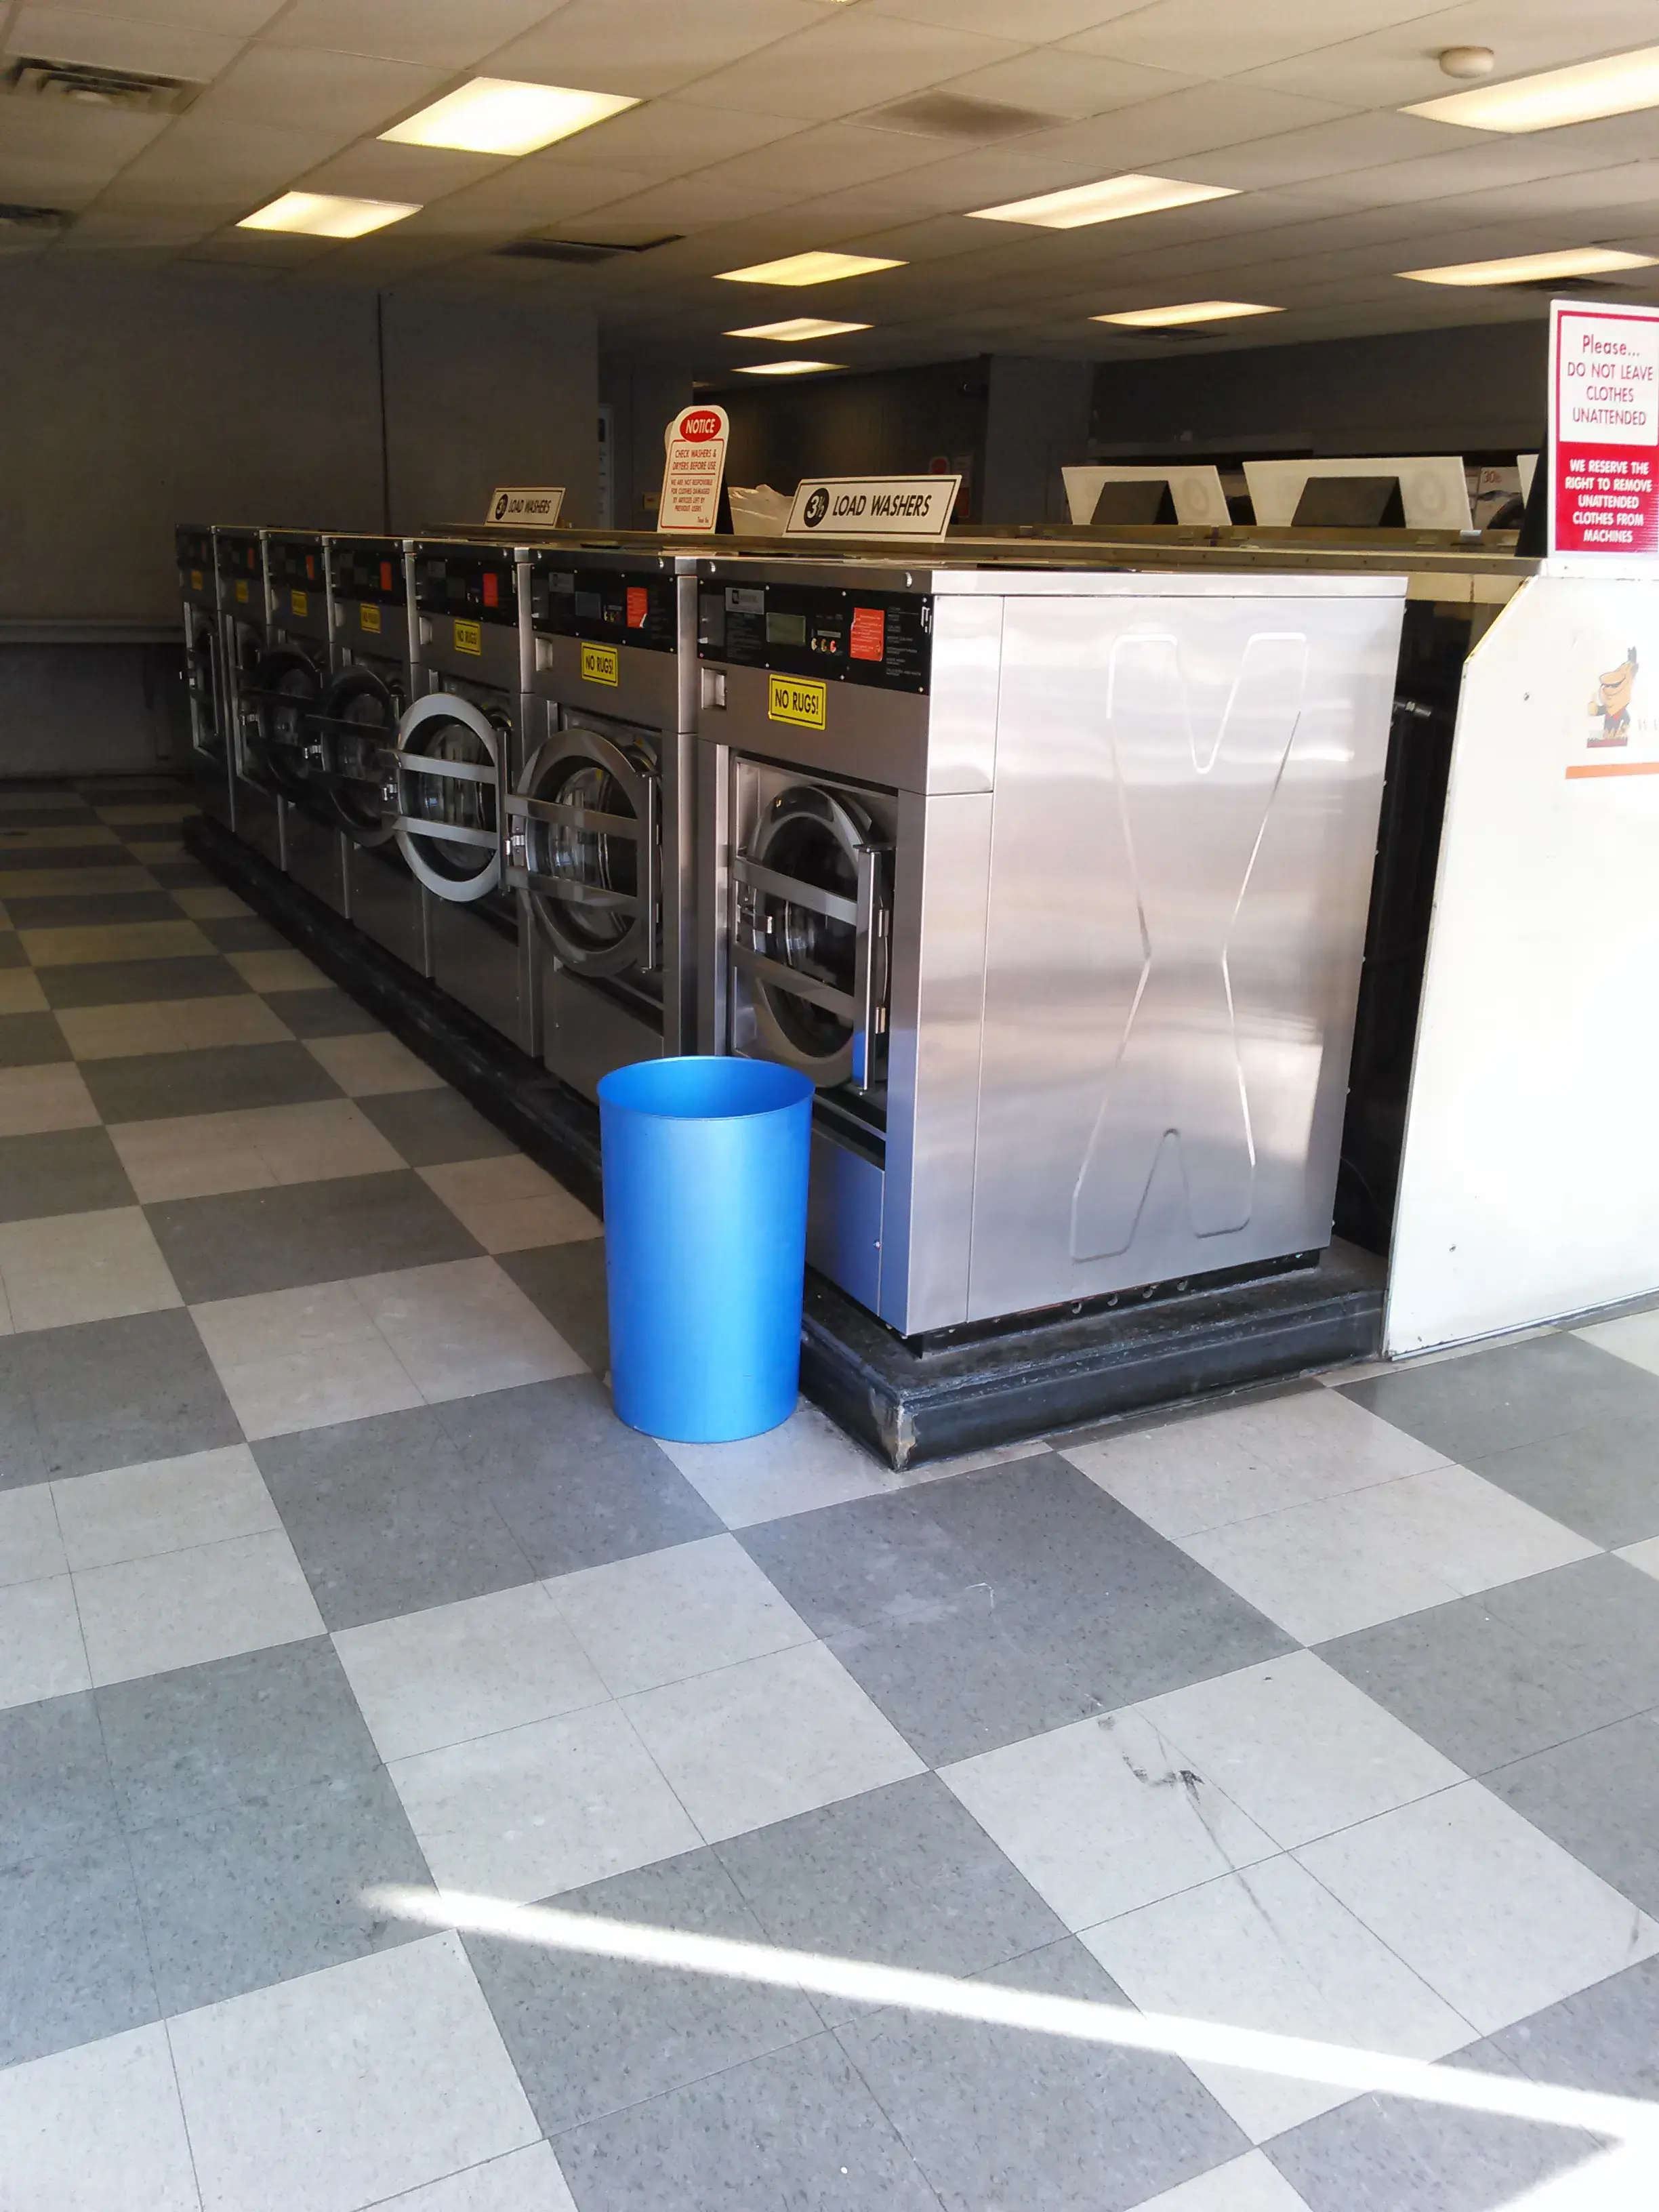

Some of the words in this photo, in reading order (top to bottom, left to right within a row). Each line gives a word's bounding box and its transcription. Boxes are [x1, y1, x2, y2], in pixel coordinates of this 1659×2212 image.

[1582, 333, 1640, 357] Please...
[1567, 361, 1586, 377] DO
[1591, 363, 1616, 379] NOT
[1620, 364, 1654, 381] LEAVE
[1586, 385, 1634, 403] CLOTHES
[1572, 407, 1647, 426] UNATTENDED
[685, 418, 716, 434] NOTICE
[675, 449, 690, 458] CHECK
[691, 449, 712, 458] WASHERS
[712, 449, 716, 457] &
[672, 462, 689, 470] DRYERS
[690, 462, 707, 470] BEFORE
[708, 461, 716, 470] USE
[1570, 459, 1586, 472] WE
[1588, 459, 1629, 474] RESERVE
[1631, 462, 1650, 474] THE
[1564, 476, 1595, 491] RIGHT
[1597, 477, 1611, 491] TO
[1613, 478, 1653, 492] REMOVE
[508, 499, 525, 513] LOAD
[525, 499, 552, 514] WASHERS
[832, 495, 867, 516] LOAD
[870, 495, 933, 517] WASHERS
[1578, 494, 1640, 509] UNATTENDED
[1572, 511, 1614, 525] CLOTHES
[1616, 513, 1644, 526] FROM
[1583, 529, 1633, 543] MACHINES
[586, 655, 595, 671] NO
[775, 689, 790, 709] NO
[792, 691, 819, 715] RUGS!
